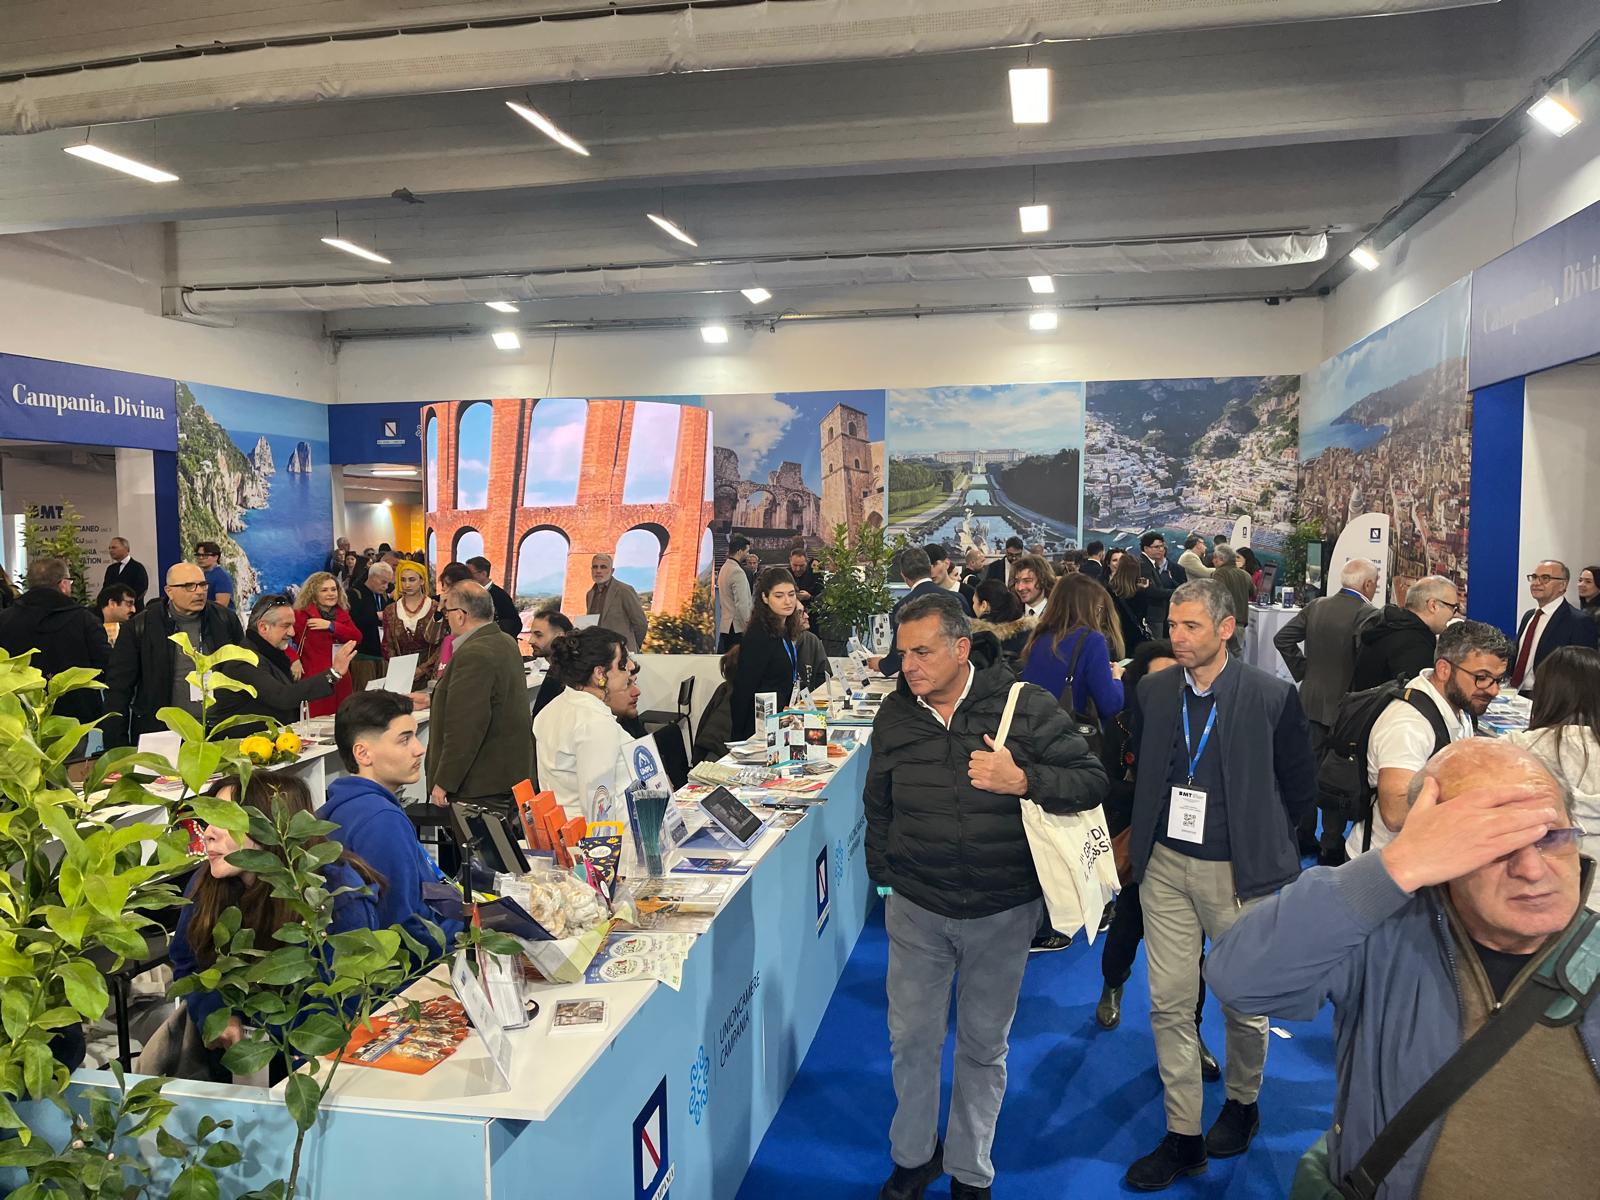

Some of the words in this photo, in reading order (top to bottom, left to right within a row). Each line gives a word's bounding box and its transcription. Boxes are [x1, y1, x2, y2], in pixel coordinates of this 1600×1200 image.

[12, 383, 111, 416] Campania.
[114, 395, 165, 420] Divina
[720, 970, 760, 1044] UNIONCAMERE
[720, 1009, 750, 1068] CAMPANIA
